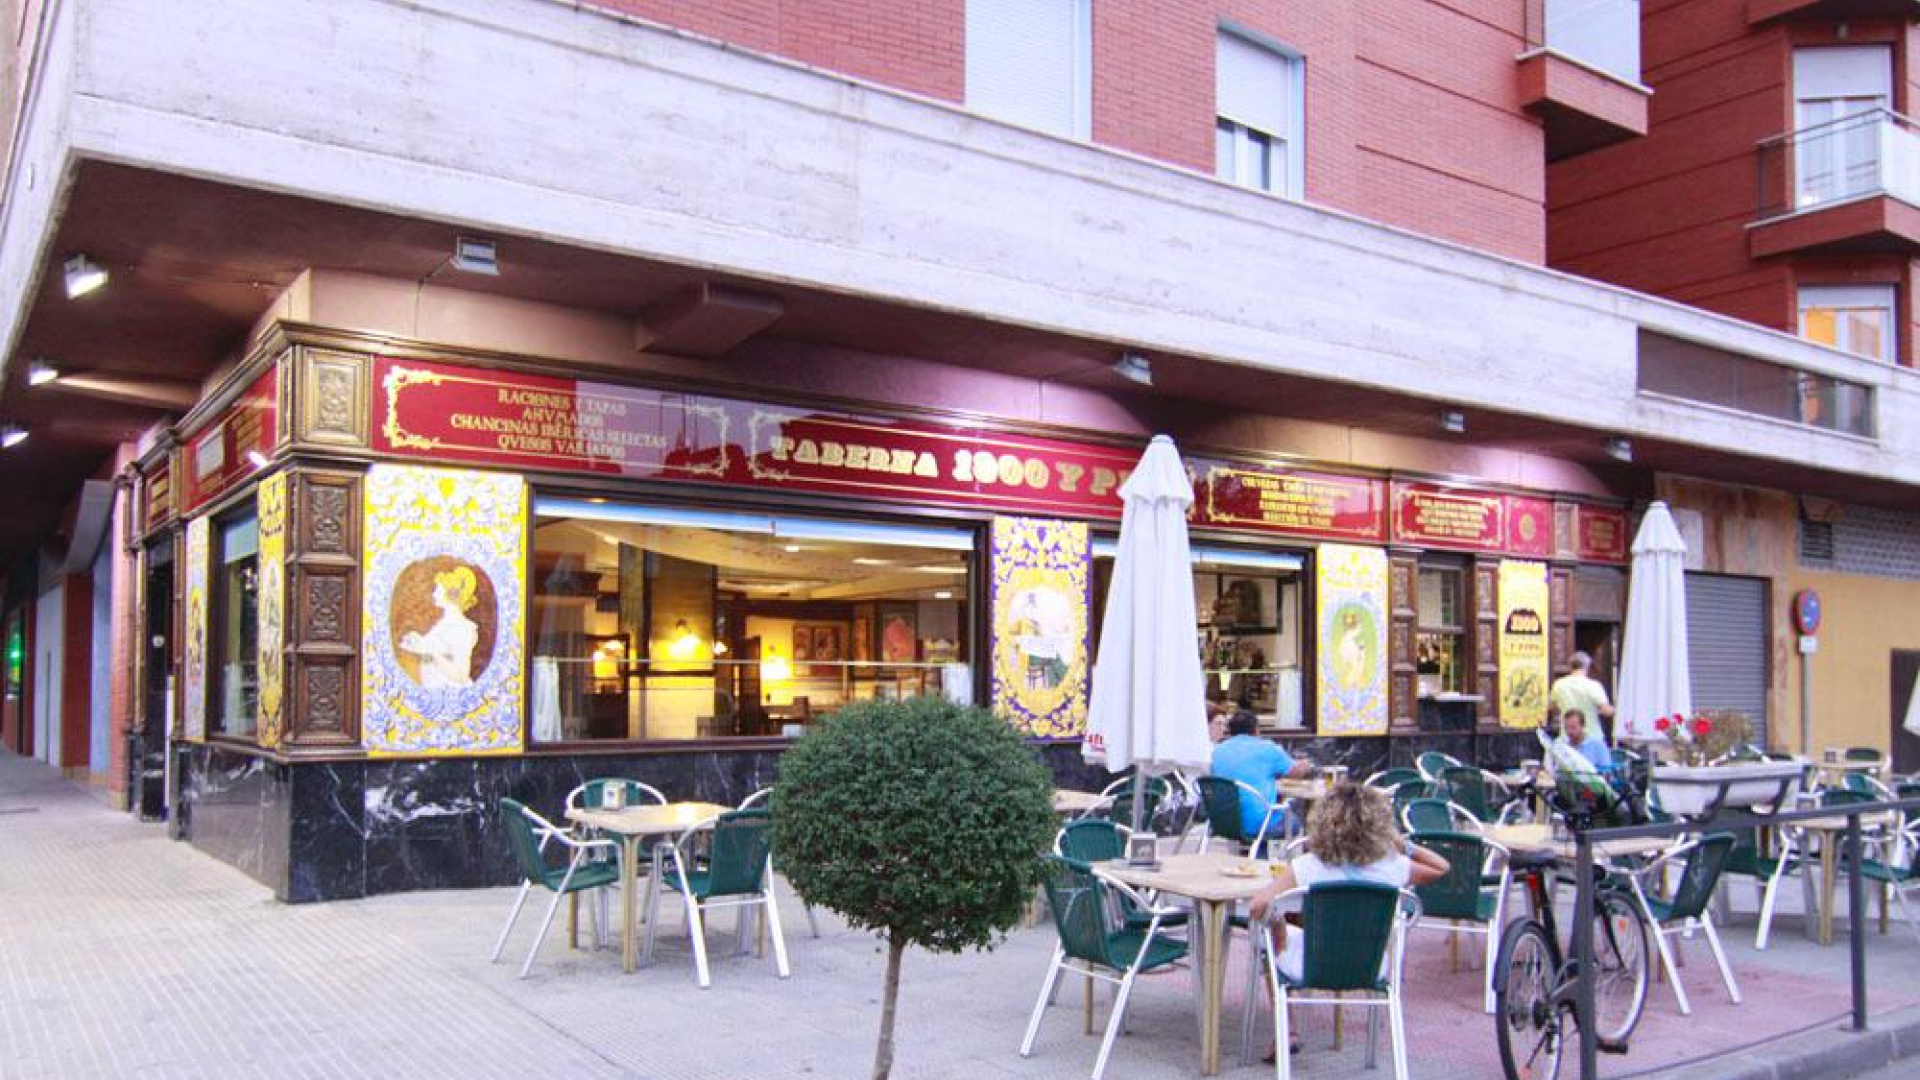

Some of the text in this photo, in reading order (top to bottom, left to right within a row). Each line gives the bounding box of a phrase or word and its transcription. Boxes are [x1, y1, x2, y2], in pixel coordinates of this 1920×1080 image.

[498, 388, 571, 411] RACIONES
[770, 435, 1131, 496] TABERNA 1900 Y P
